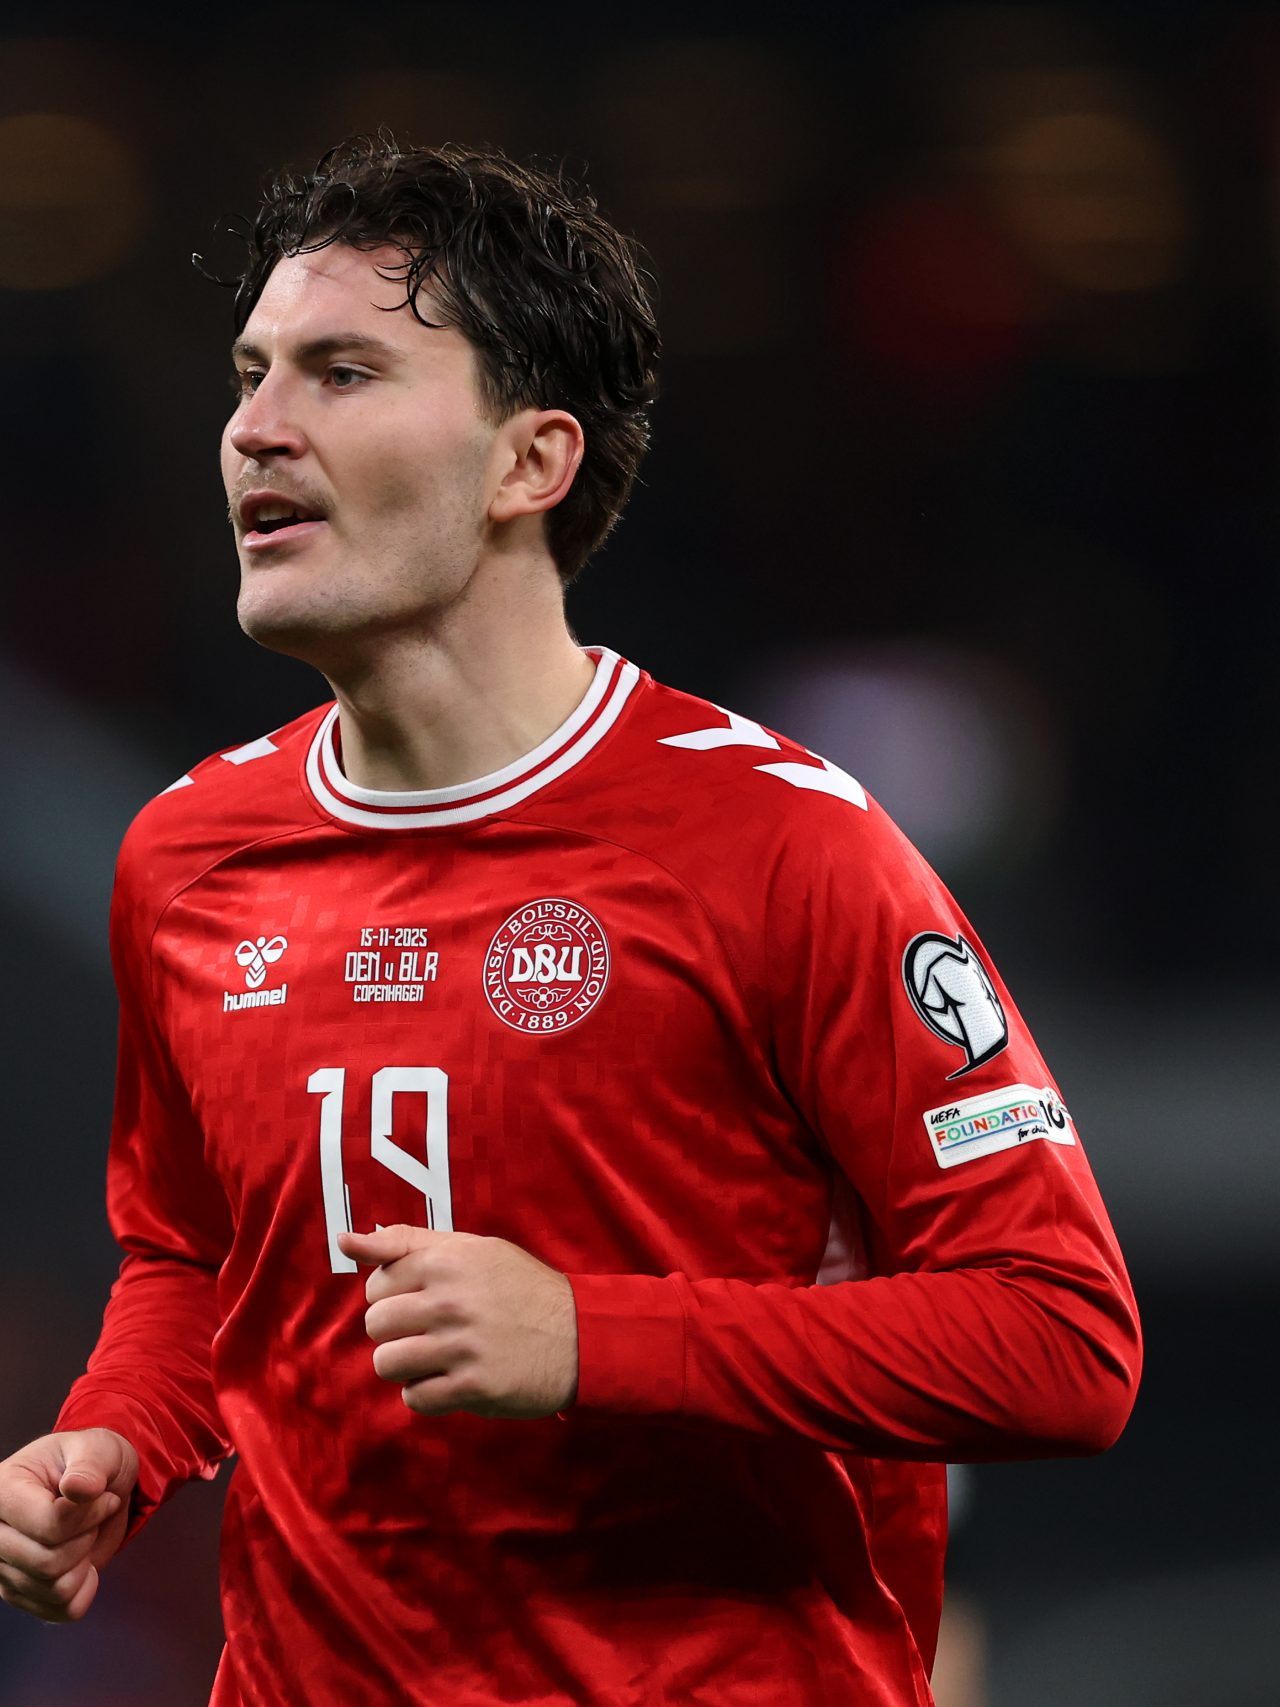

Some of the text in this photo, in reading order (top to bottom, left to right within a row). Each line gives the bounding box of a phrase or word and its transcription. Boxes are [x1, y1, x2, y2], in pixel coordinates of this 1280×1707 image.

[361, 928, 428, 947] 15-11-2025
[345, 952, 380, 982] DEN
[399, 952, 439, 982] BLR
[508, 943, 584, 984] DBU
[487, 938, 513, 1015] DANSK
[223, 983, 288, 1012] hummel
[353, 984, 425, 1002] COPENHAGEN
[515, 1010, 569, 1030] 1889
[930, 1107, 961, 1125] UEFA
[1017, 1128, 1030, 1142] for
[307, 1066, 454, 1274] 19
